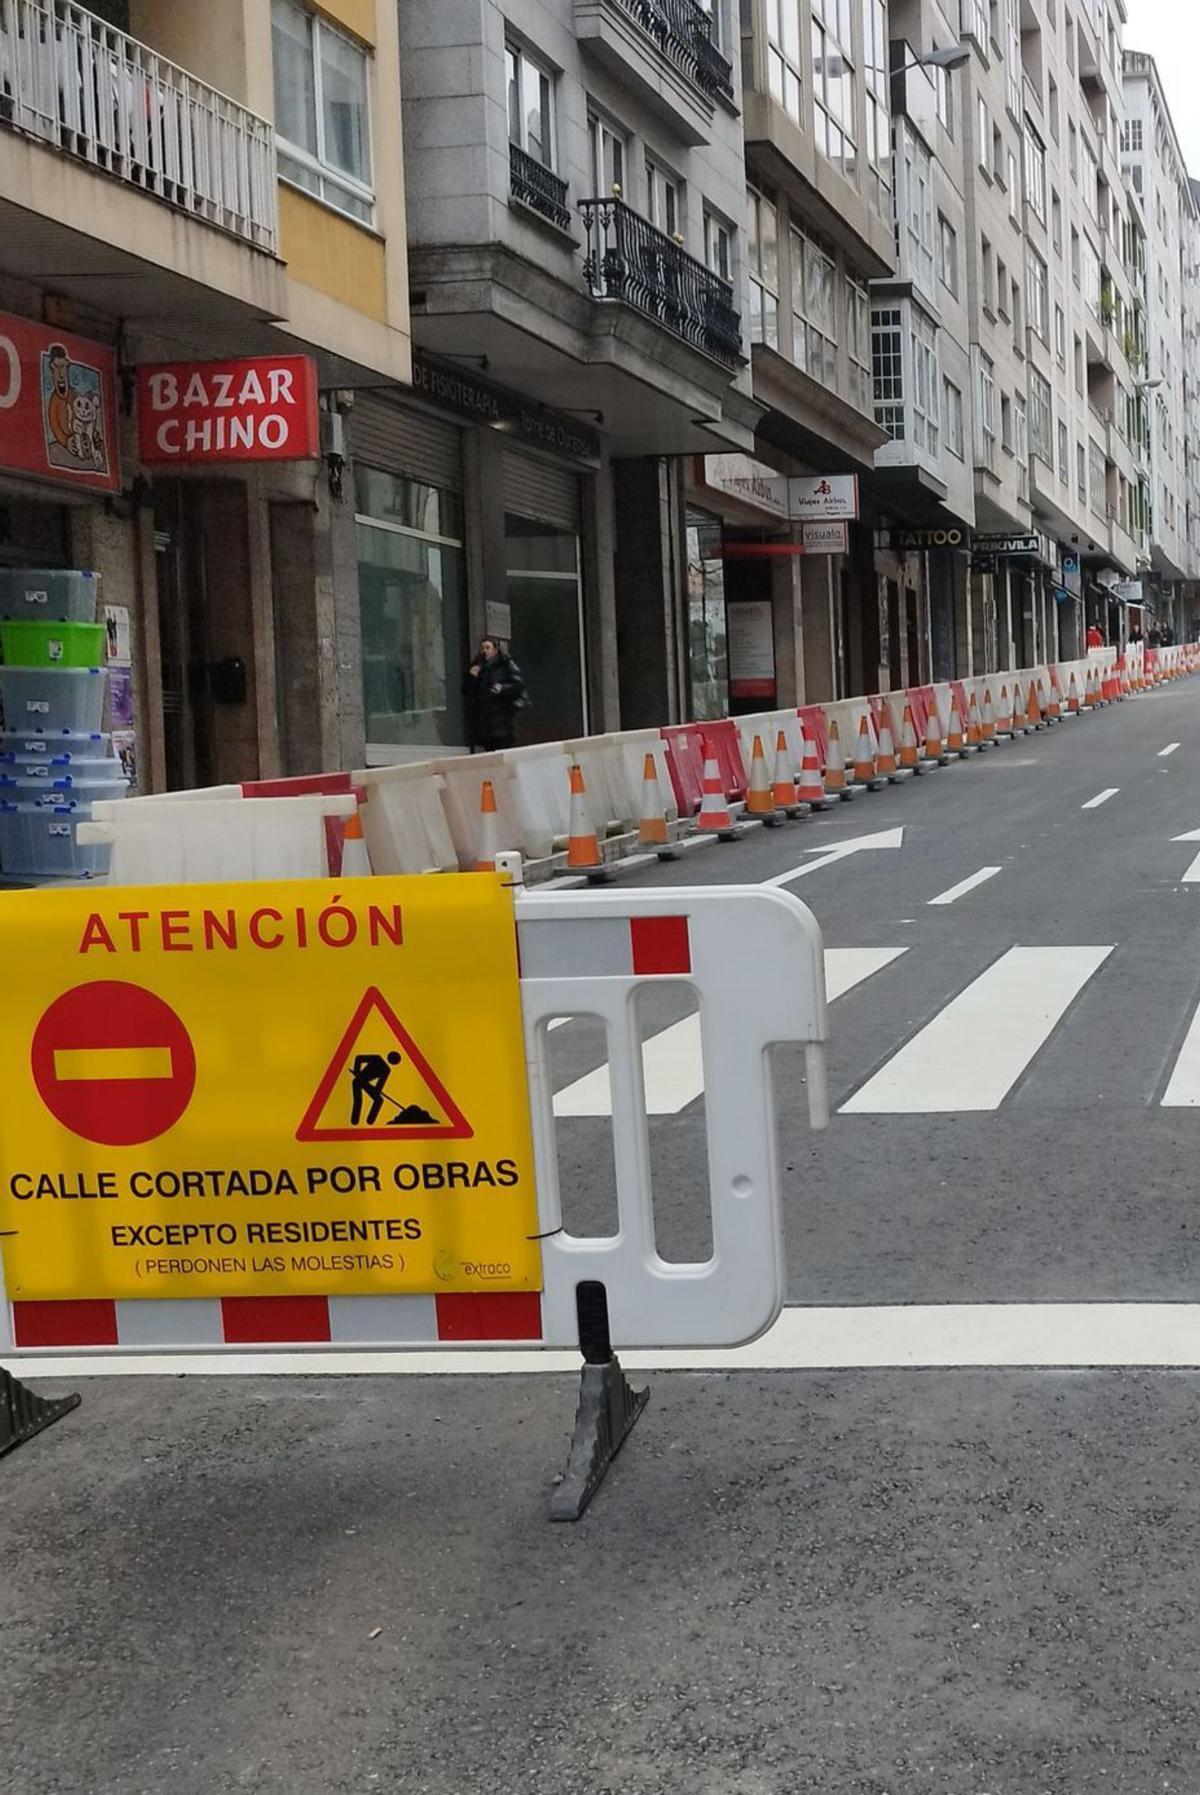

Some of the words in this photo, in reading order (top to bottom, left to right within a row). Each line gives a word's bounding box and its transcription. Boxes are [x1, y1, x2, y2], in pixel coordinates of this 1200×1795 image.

[149, 368, 296, 411] BAZAR
[156, 413, 289, 454] CHINO
[798, 497, 820, 508] Viajes
[897, 529, 962, 546] TATTOO
[78, 894, 404, 955] ATENCIÓN
[9, 1172, 119, 1201] CALLE
[129, 1168, 298, 1198] CORTADA
[307, 1164, 382, 1195] POR
[392, 1159, 520, 1190] OBRAS
[111, 1224, 237, 1247] EXCEPTO
[246, 1218, 422, 1244] RESIDENTES
[251, 1258, 285, 1274] LAS
